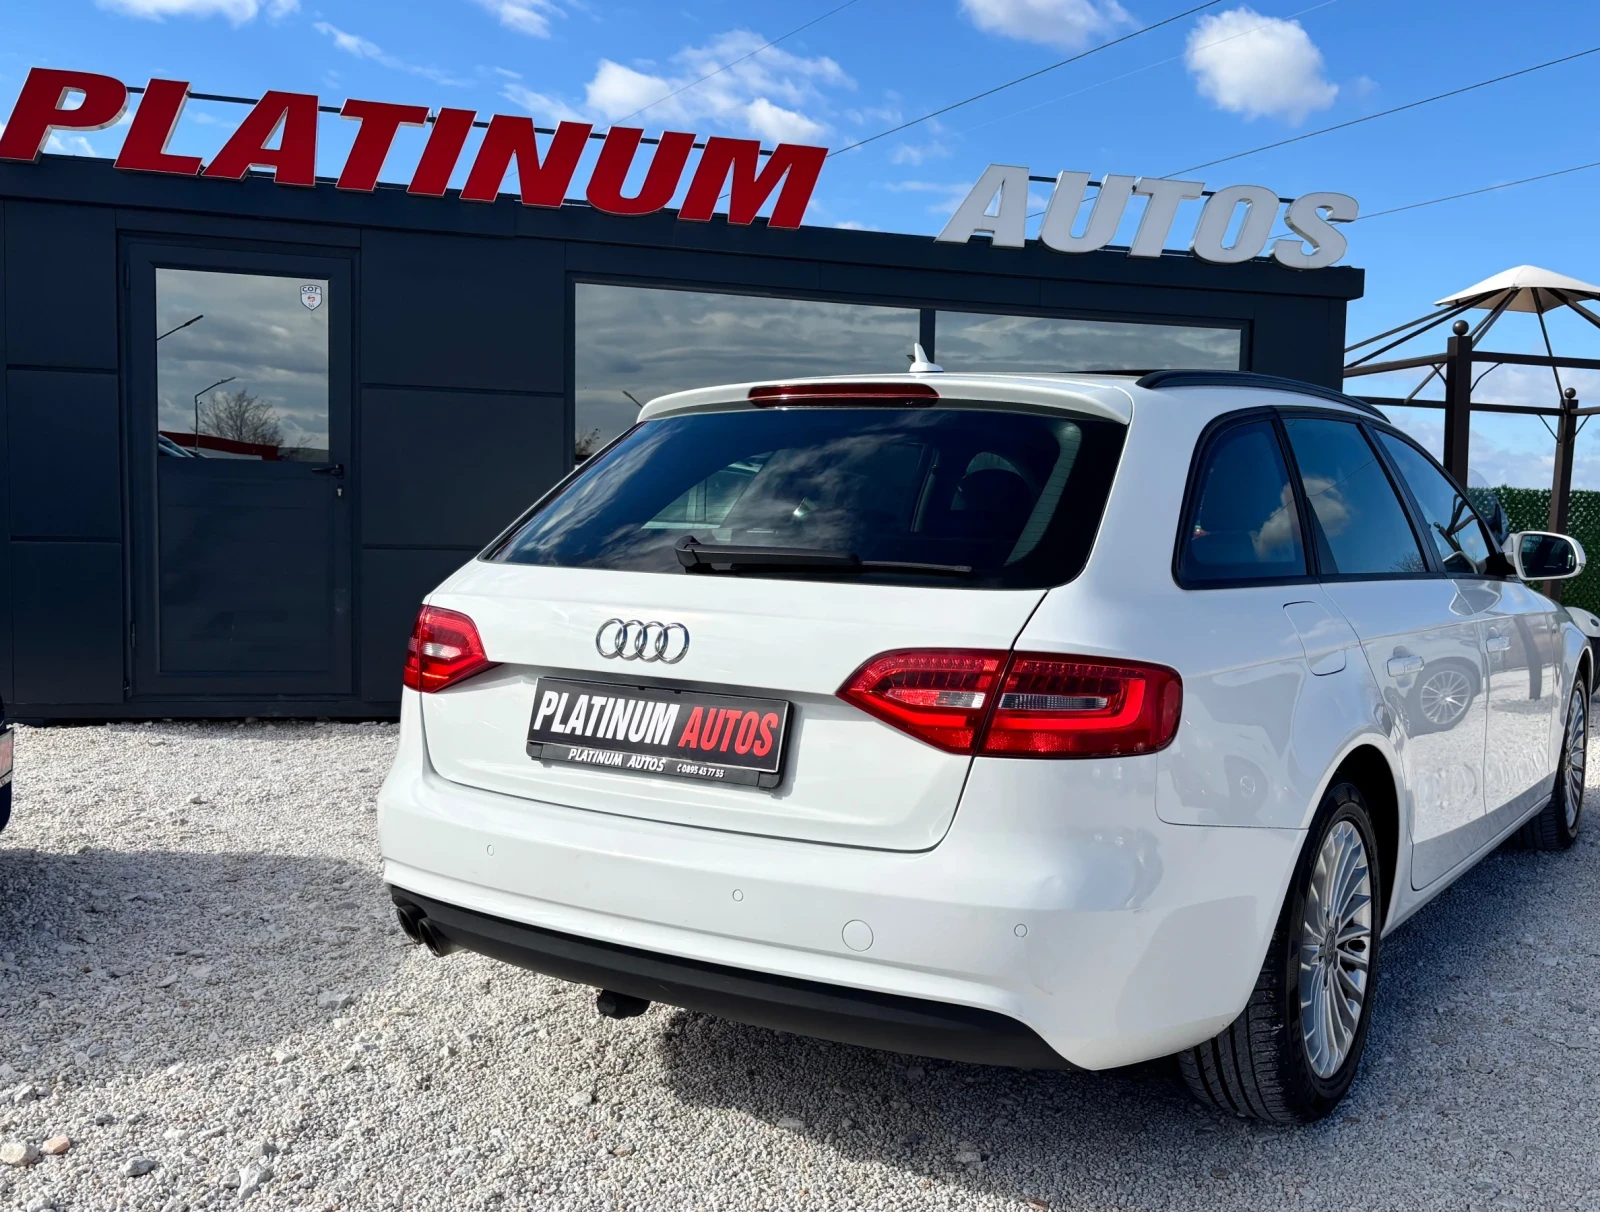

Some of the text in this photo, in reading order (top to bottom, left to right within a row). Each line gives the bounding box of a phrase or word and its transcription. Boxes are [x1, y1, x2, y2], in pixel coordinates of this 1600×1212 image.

[0, 67, 1359, 270] PLATINUM AUTOS
[533, 690, 779, 756] PLATINUM AUTOS
[568, 748, 666, 771] PLATINUM AUTOS
